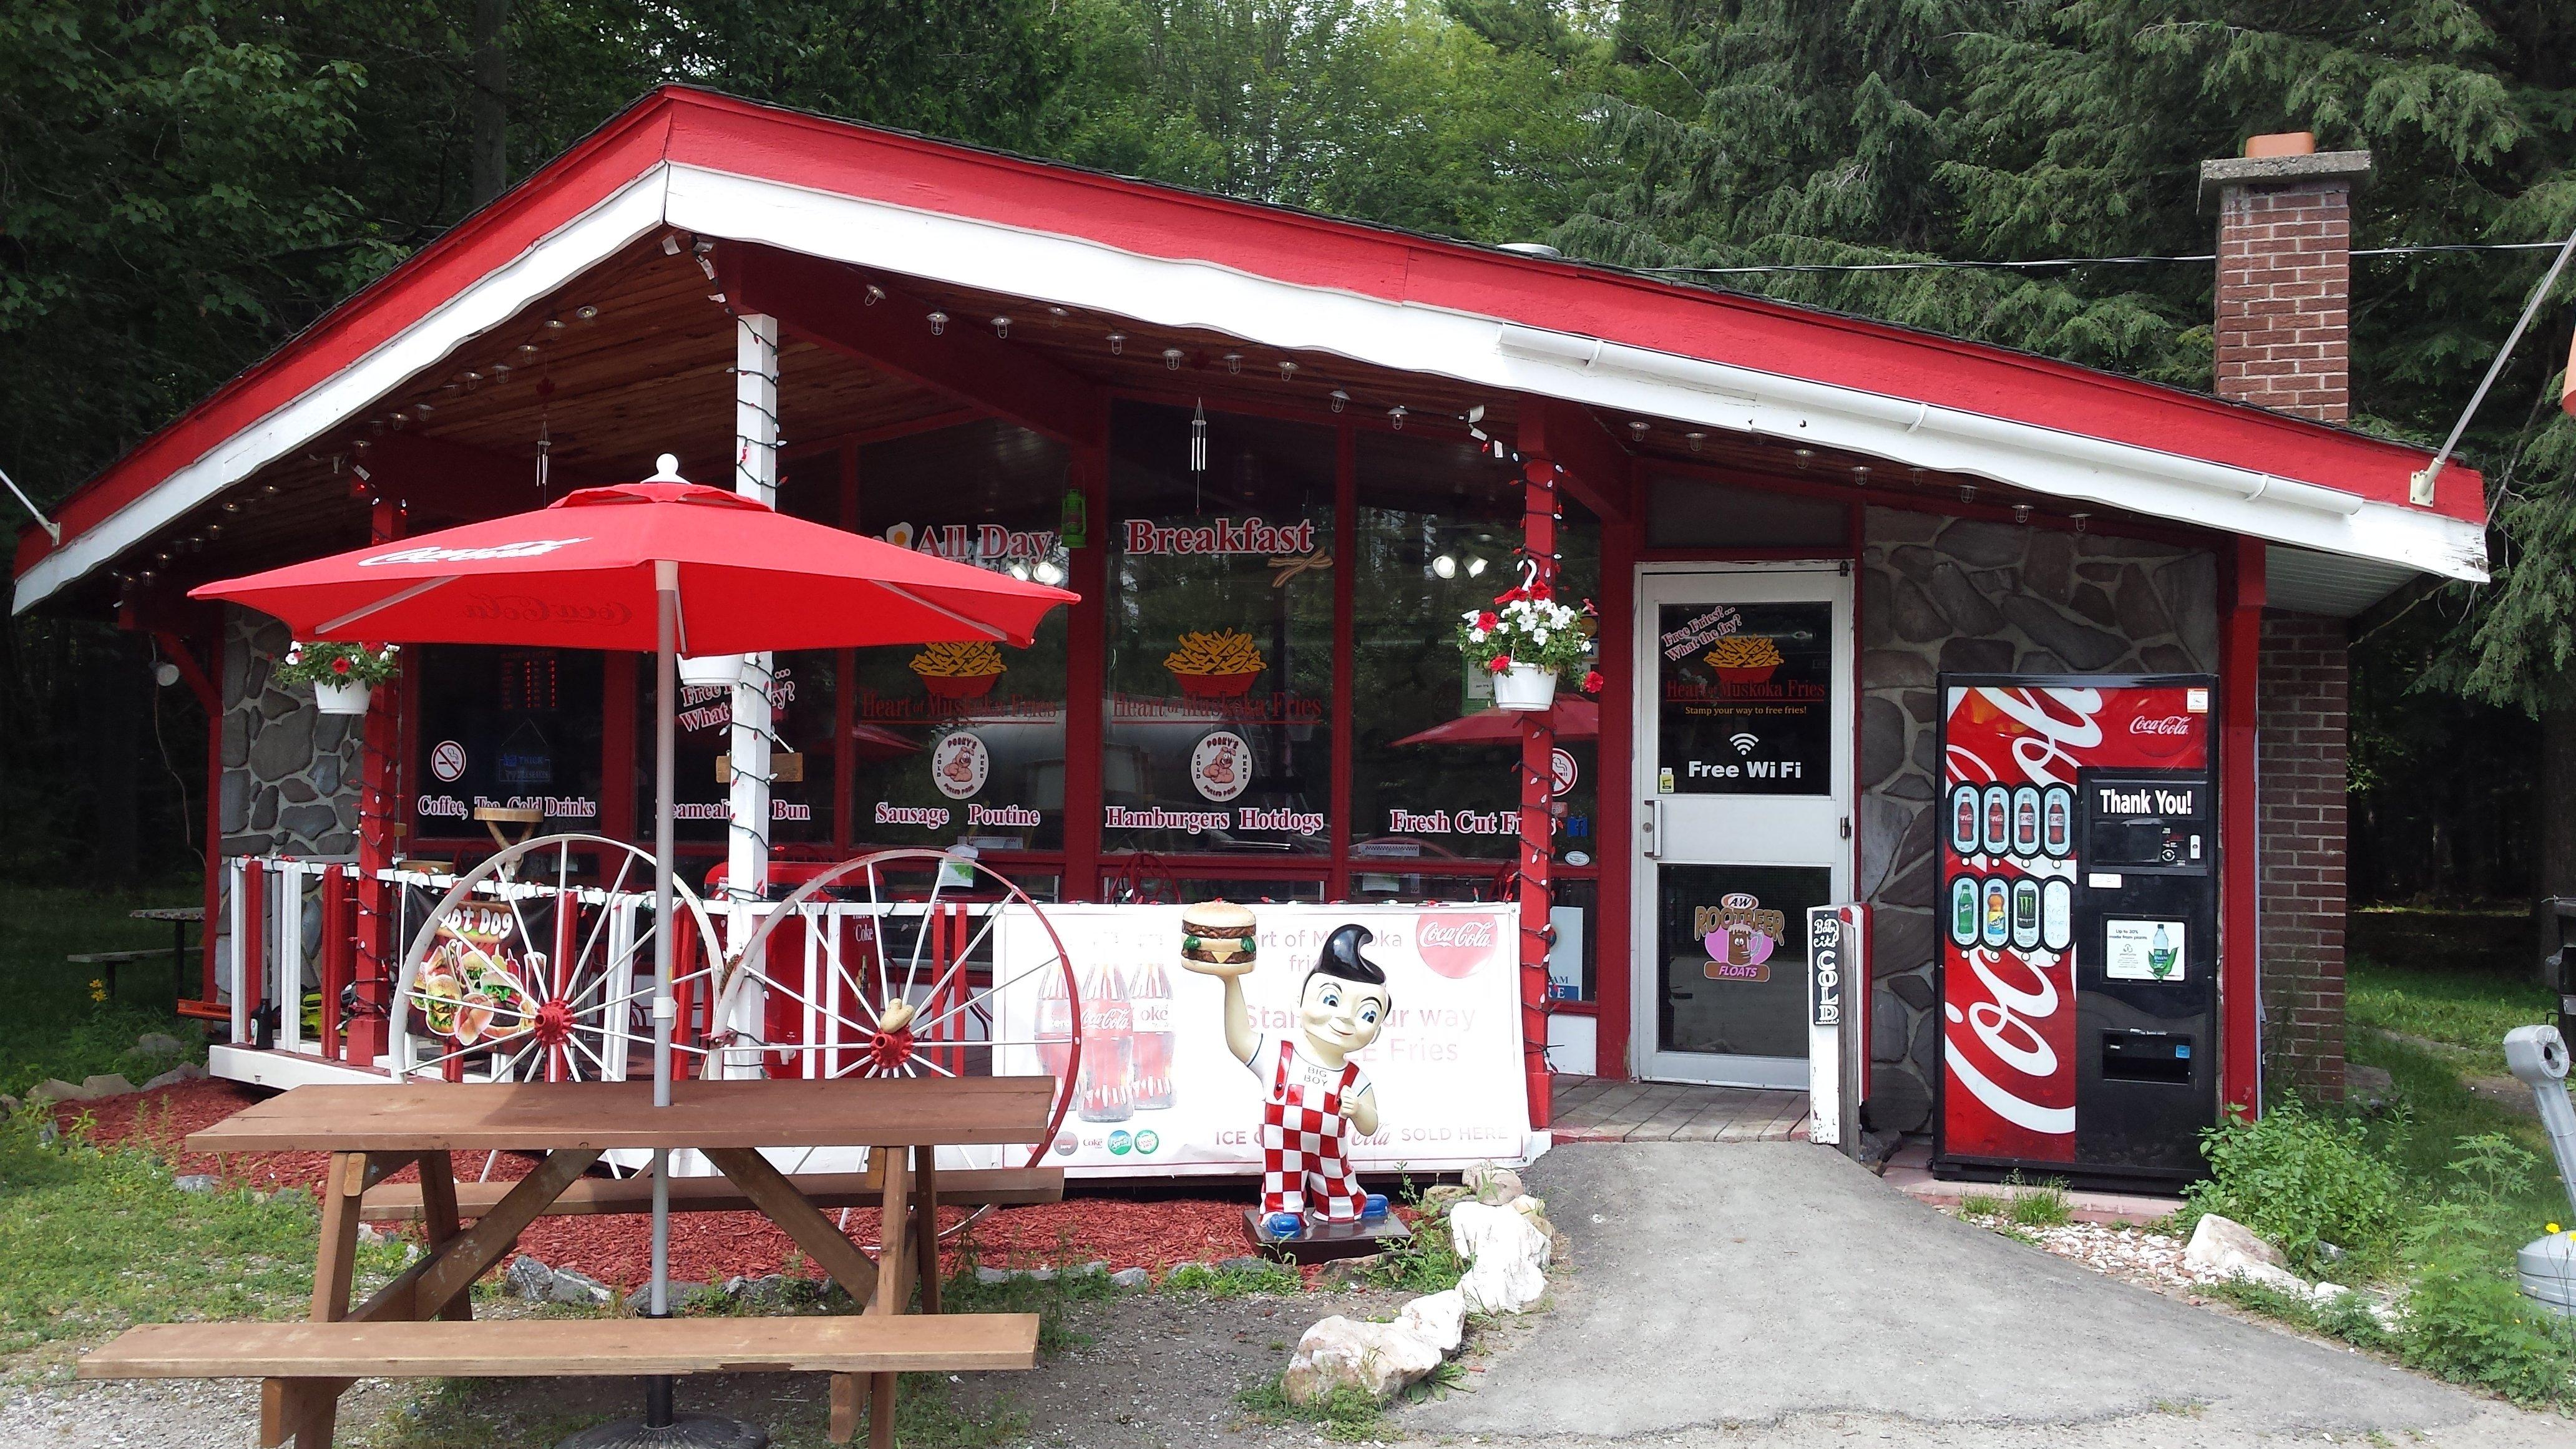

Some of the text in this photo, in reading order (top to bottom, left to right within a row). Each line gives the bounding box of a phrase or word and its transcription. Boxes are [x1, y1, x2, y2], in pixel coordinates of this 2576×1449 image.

[916, 524, 1054, 565] All Day
[1125, 517, 1314, 555] Breakfast
[1661, 627, 1690, 647] Free
[1664, 613, 1742, 661] What the fry?
[681, 685, 724, 707] Free
[1720, 680, 1782, 697] Muskoka
[1787, 680, 1825, 697] Fries
[680, 681, 796, 732] What ry?
[862, 693, 910, 717] Heart
[1010, 693, 1056, 717] Fries
[1113, 691, 1322, 717] Heart of Muskoka Fries
[1685, 706, 1712, 716] Stamp
[1713, 708, 1733, 716] your
[1735, 708, 1752, 716] way
[1784, 706, 1807, 714] fries!
[2129, 715, 2192, 735] Coca-Cola
[1689, 761, 1739, 778] Free
[418, 795, 469, 821] Coffee,
[544, 797, 596, 817] Drinks
[659, 799, 811, 821] eameal Bun
[2099, 788, 2193, 815] Thank You!
[876, 802, 1040, 829] Sausage Poutine
[1105, 806, 1324, 836] Hamburgers Hotdogs
[1389, 809, 1451, 833] Fresh
[1455, 810, 1497, 834] Cut
[478, 908, 513, 939] Dog
[856, 924, 873, 942] Coke
[1420, 921, 1495, 947] Coca-Cola
[1813, 919, 1839, 942] Baby
[1285, 930, 1305, 947] of
[1719, 965, 1758, 977] FLOATS
[1817, 950, 1839, 1020] COLD
[1419, 1008, 1476, 1032] way
[1390, 1038, 1458, 1062] Fries
[1304, 1074, 1328, 1086] BOY
[1308, 1067, 1327, 1078] BIG
[1216, 1131, 1247, 1146] ICE
[1402, 1127, 1452, 1142] SOLD
[1460, 1126, 1509, 1141] HERE
